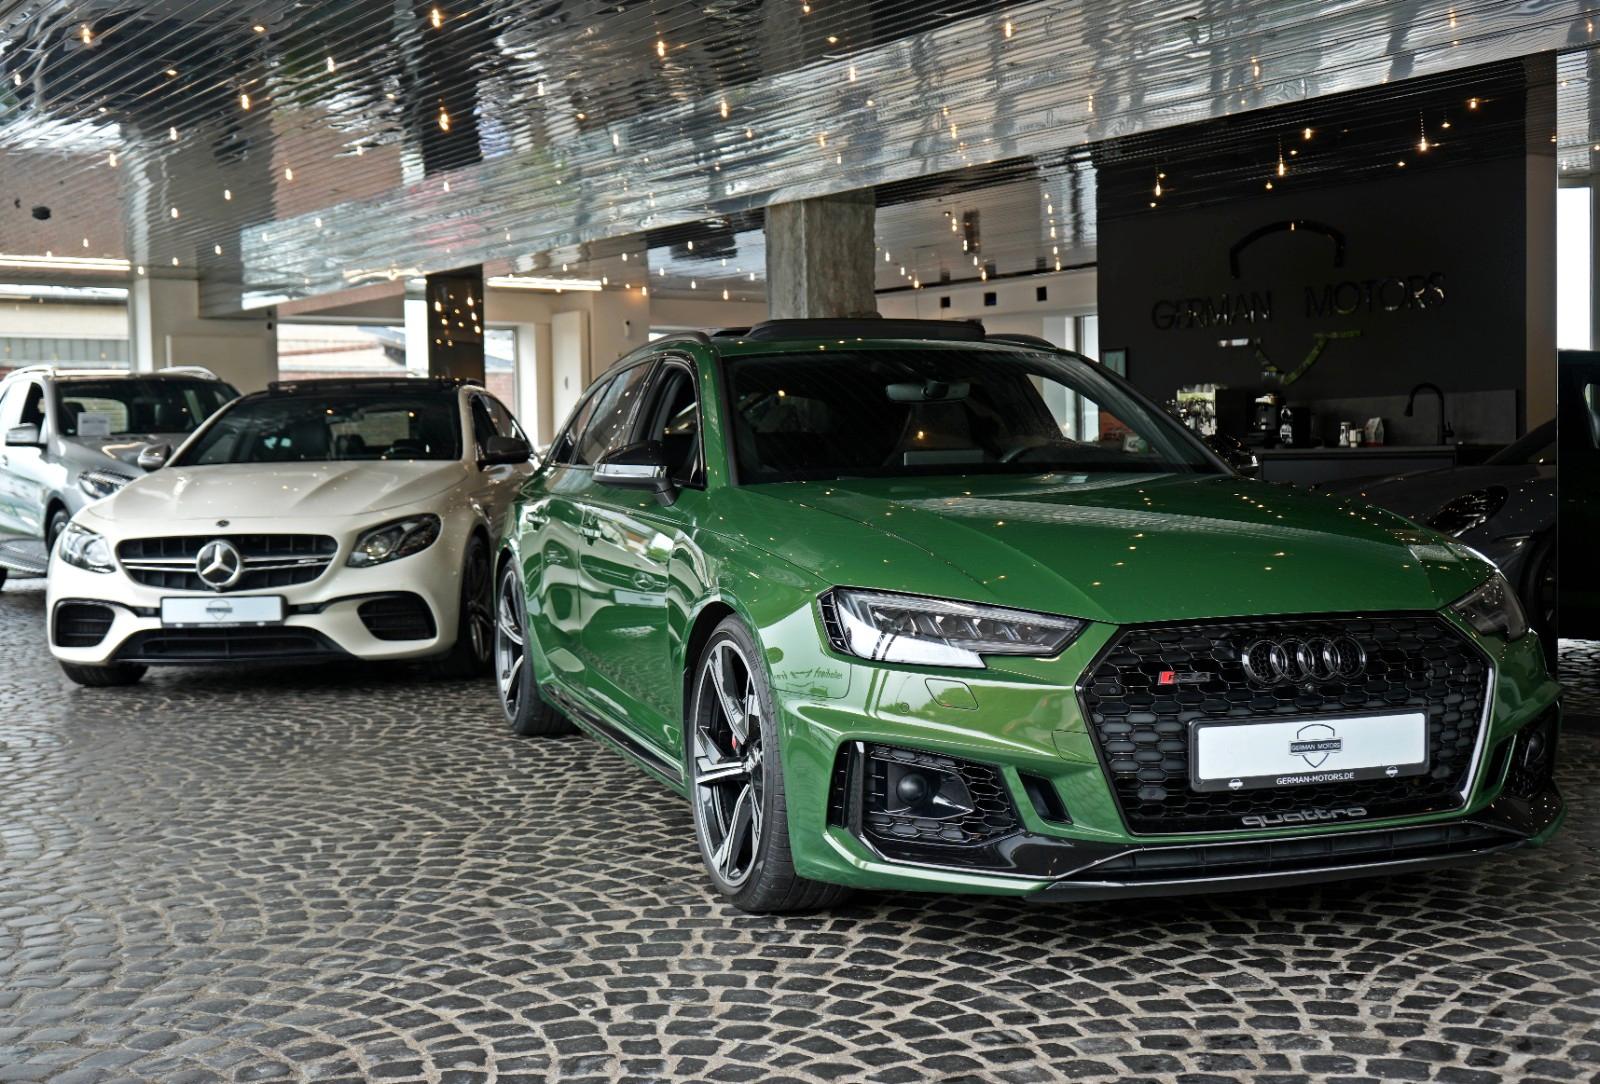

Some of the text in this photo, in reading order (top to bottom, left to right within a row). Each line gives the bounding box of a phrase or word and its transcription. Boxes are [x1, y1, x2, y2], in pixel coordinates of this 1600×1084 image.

[1151, 272, 1445, 330] GERMAN MOTORS
[1291, 742, 1341, 751] GERMAN MOTORS
[1276, 772, 1354, 785] GERMAN-MOTORS.DE
[1241, 806, 1368, 827] quattro
